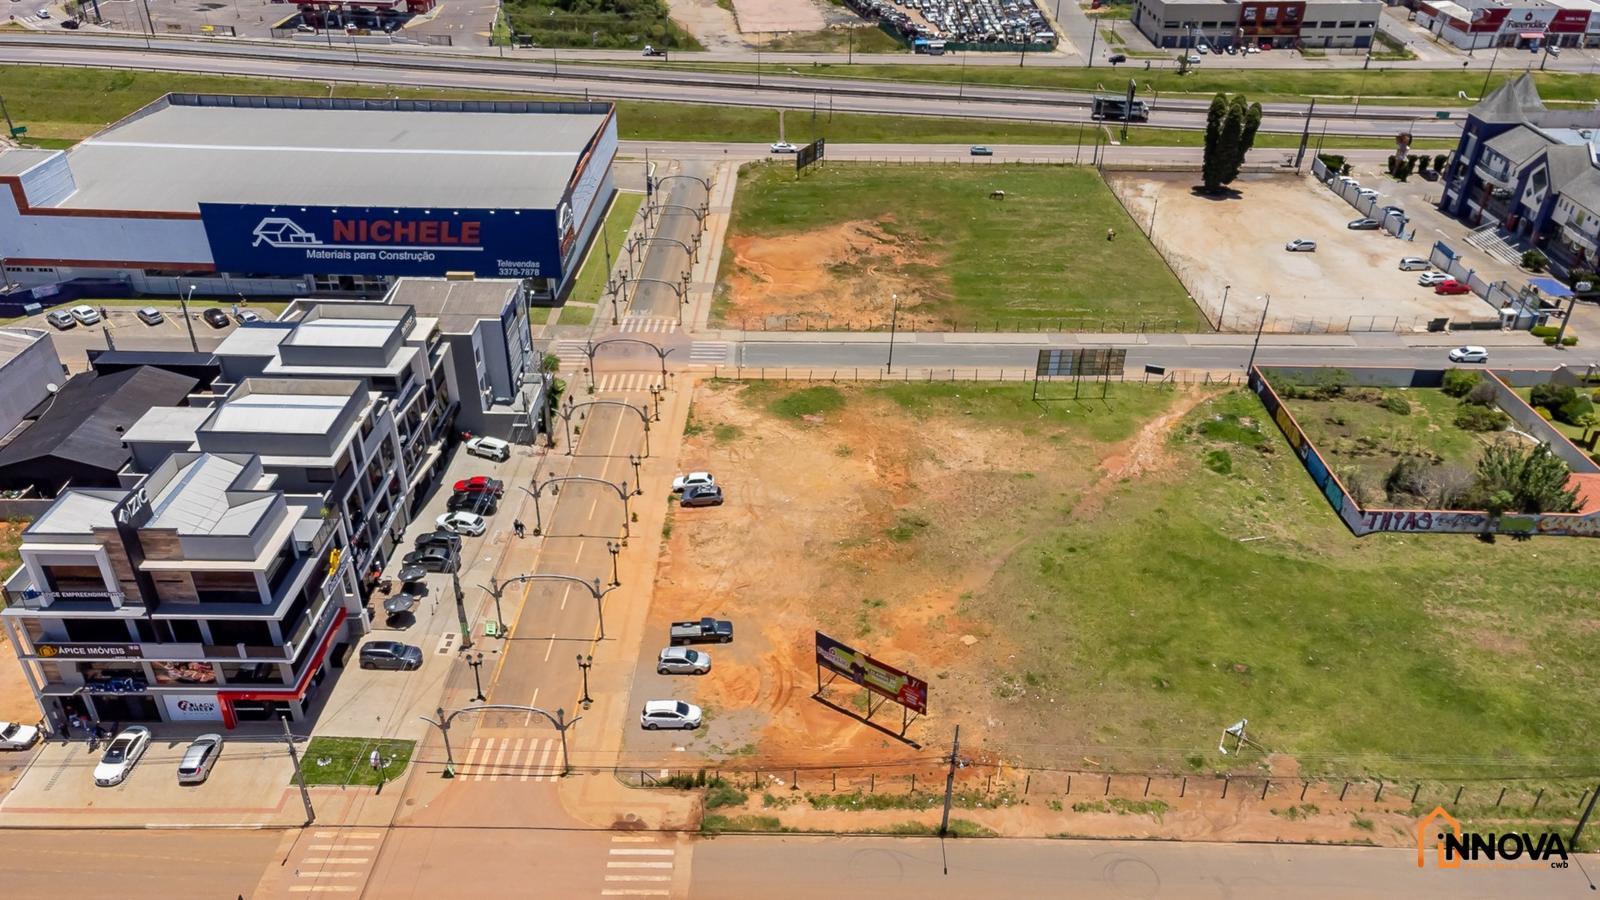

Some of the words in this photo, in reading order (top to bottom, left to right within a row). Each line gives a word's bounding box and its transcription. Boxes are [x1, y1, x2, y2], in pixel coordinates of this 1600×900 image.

[332, 219, 481, 244] NICHELE
[306, 249, 351, 260] Materiais
[353, 251, 376, 262] para
[378, 251, 435, 262] Construção
[497, 259, 540, 268] Televendas
[499, 268, 540, 276] 3378-7878
[59, 646, 86, 655] ÁPICE
[87, 646, 126, 655] IMÓVEIS
